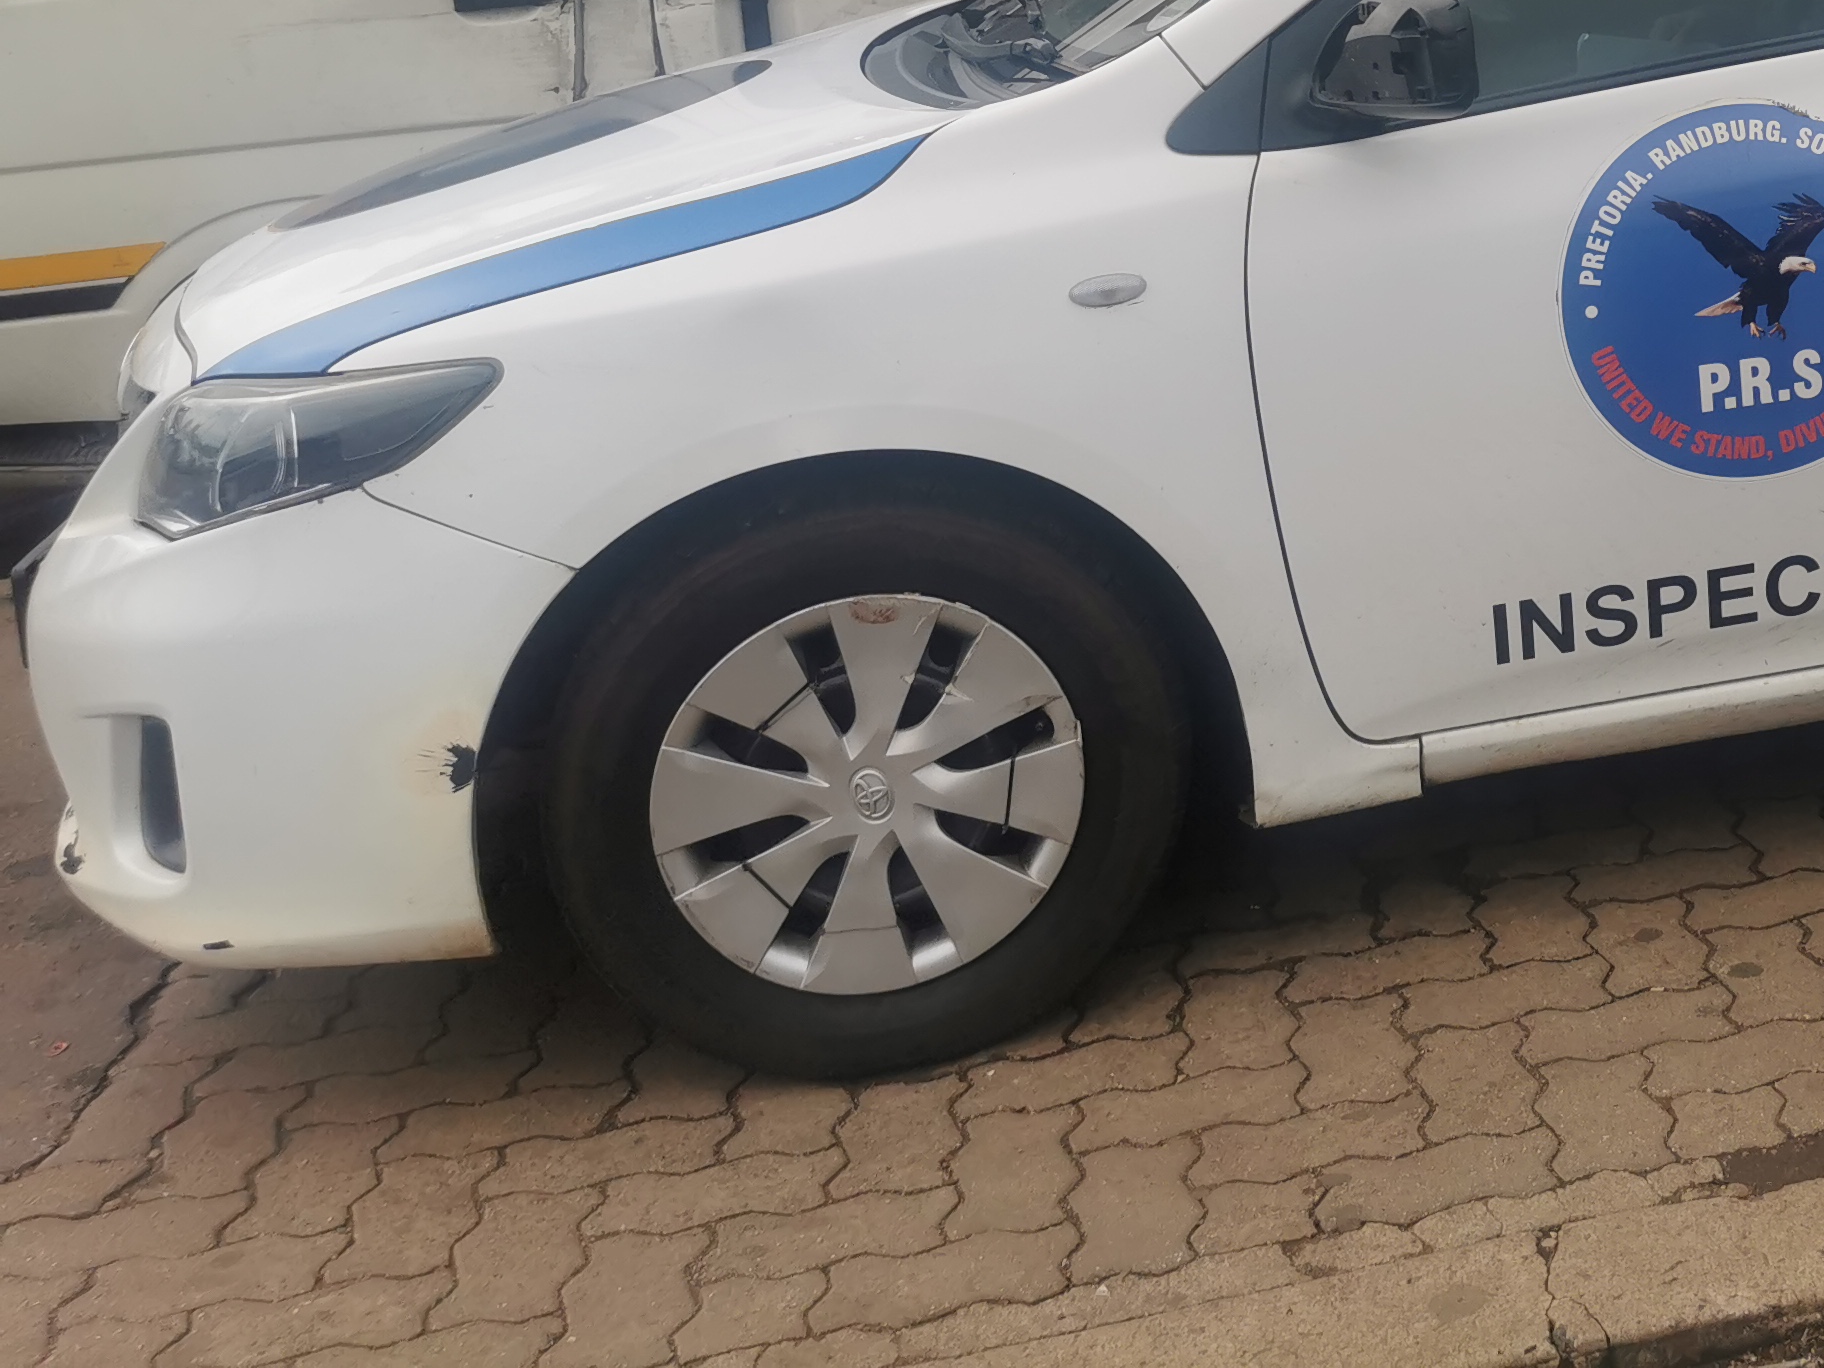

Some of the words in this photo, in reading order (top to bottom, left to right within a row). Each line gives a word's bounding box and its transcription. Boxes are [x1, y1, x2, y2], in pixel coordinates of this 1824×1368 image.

[1578, 168, 1654, 287] PRETORIA.
[1647, 119, 1787, 171] RANDBURG.
[1591, 344, 1655, 424] UNITED
[1649, 410, 1692, 448] WE
[1690, 430, 1774, 462] STAND,
[1698, 348, 1823, 414] P.R.S
